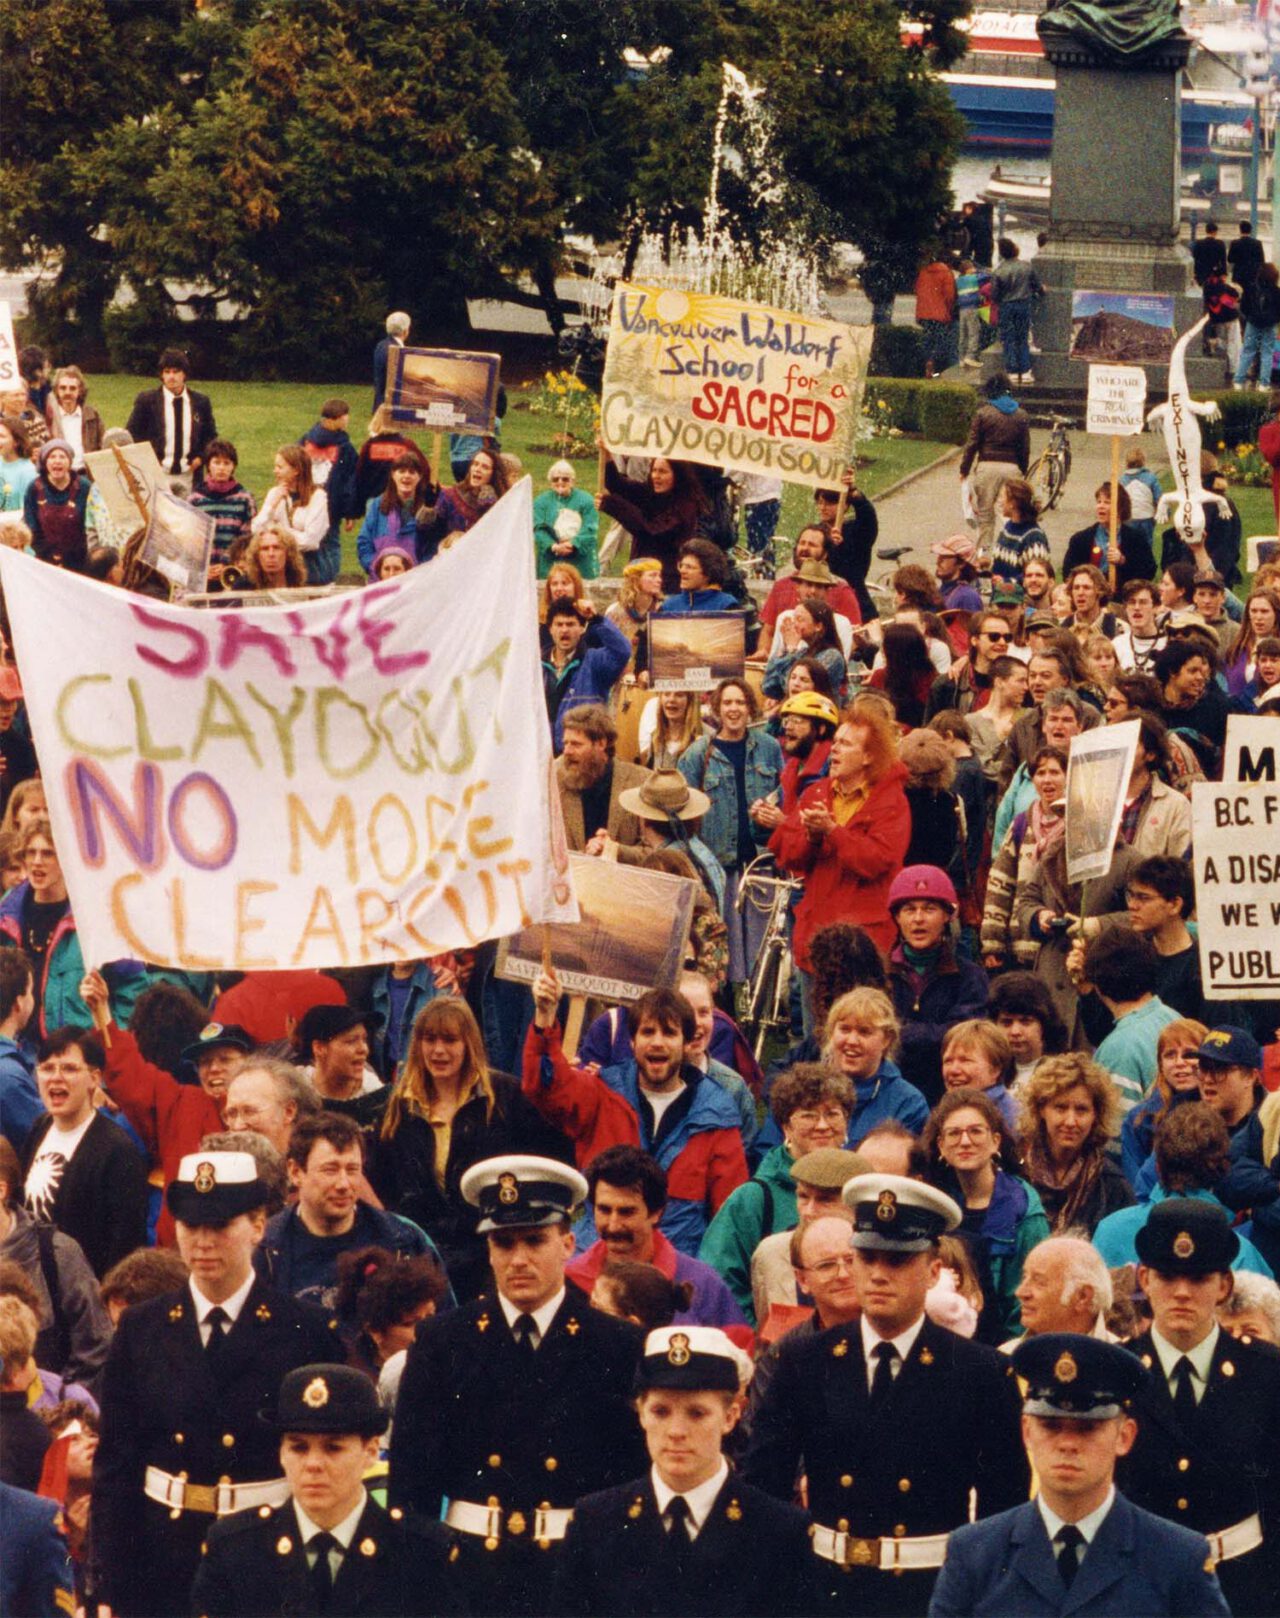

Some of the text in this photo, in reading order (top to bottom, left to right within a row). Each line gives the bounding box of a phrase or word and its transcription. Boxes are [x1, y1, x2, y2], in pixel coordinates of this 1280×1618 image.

[659, 344, 767, 385] School
[740, 311, 844, 369] Waldorf
[782, 363, 849, 400] for a
[691, 381, 837, 444] SACRED
[1171, 393, 1195, 538] EXTINCTIONS
[128, 584, 431, 681] SAVE
[62, 756, 517, 885] NO MORE
[1203, 856, 1220, 886] A
[110, 857, 533, 968] CLEARCUT
[1221, 903, 1260, 928] WE
[545, 969, 618, 994] AYOQUOT
